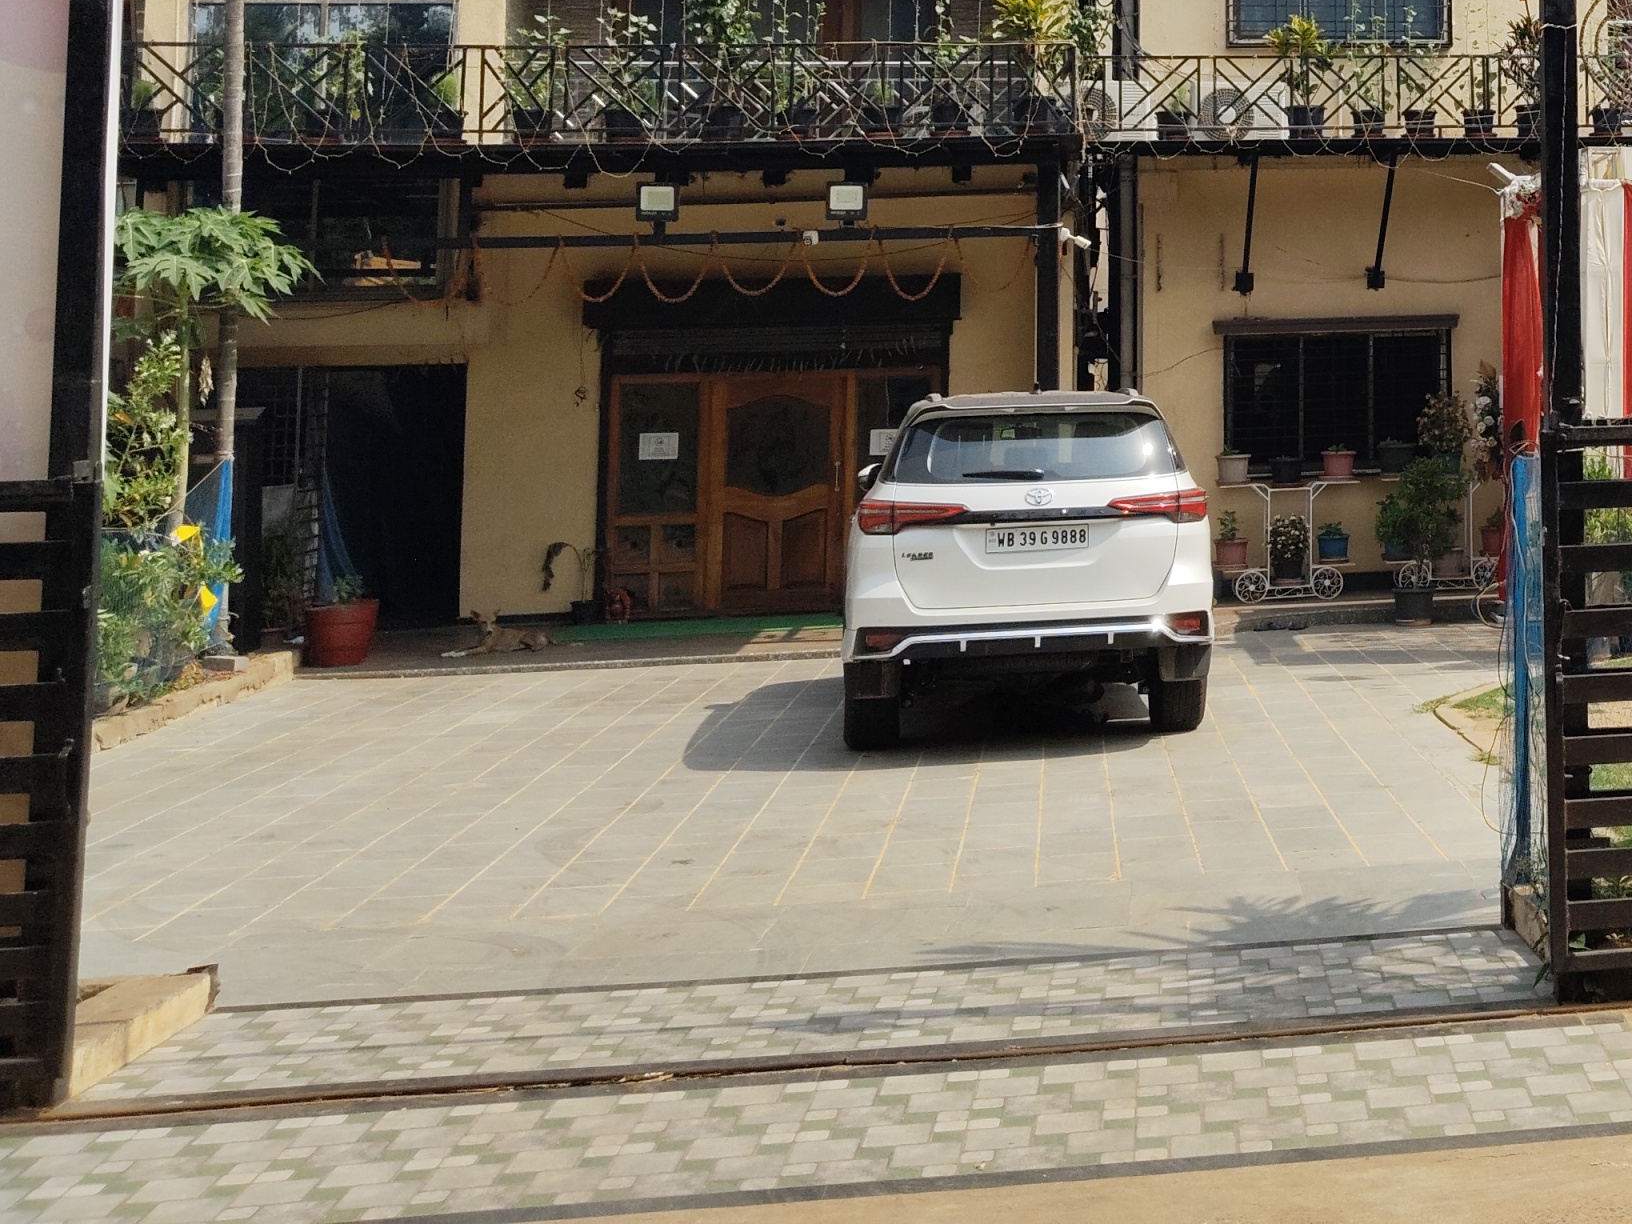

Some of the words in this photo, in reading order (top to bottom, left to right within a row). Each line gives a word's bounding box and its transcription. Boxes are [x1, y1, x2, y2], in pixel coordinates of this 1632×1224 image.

[997, 532, 1015, 547] WB
[1019, 531, 1036, 546] 39
[1040, 530, 1048, 545] G
[1051, 529, 1087, 544] 9888
